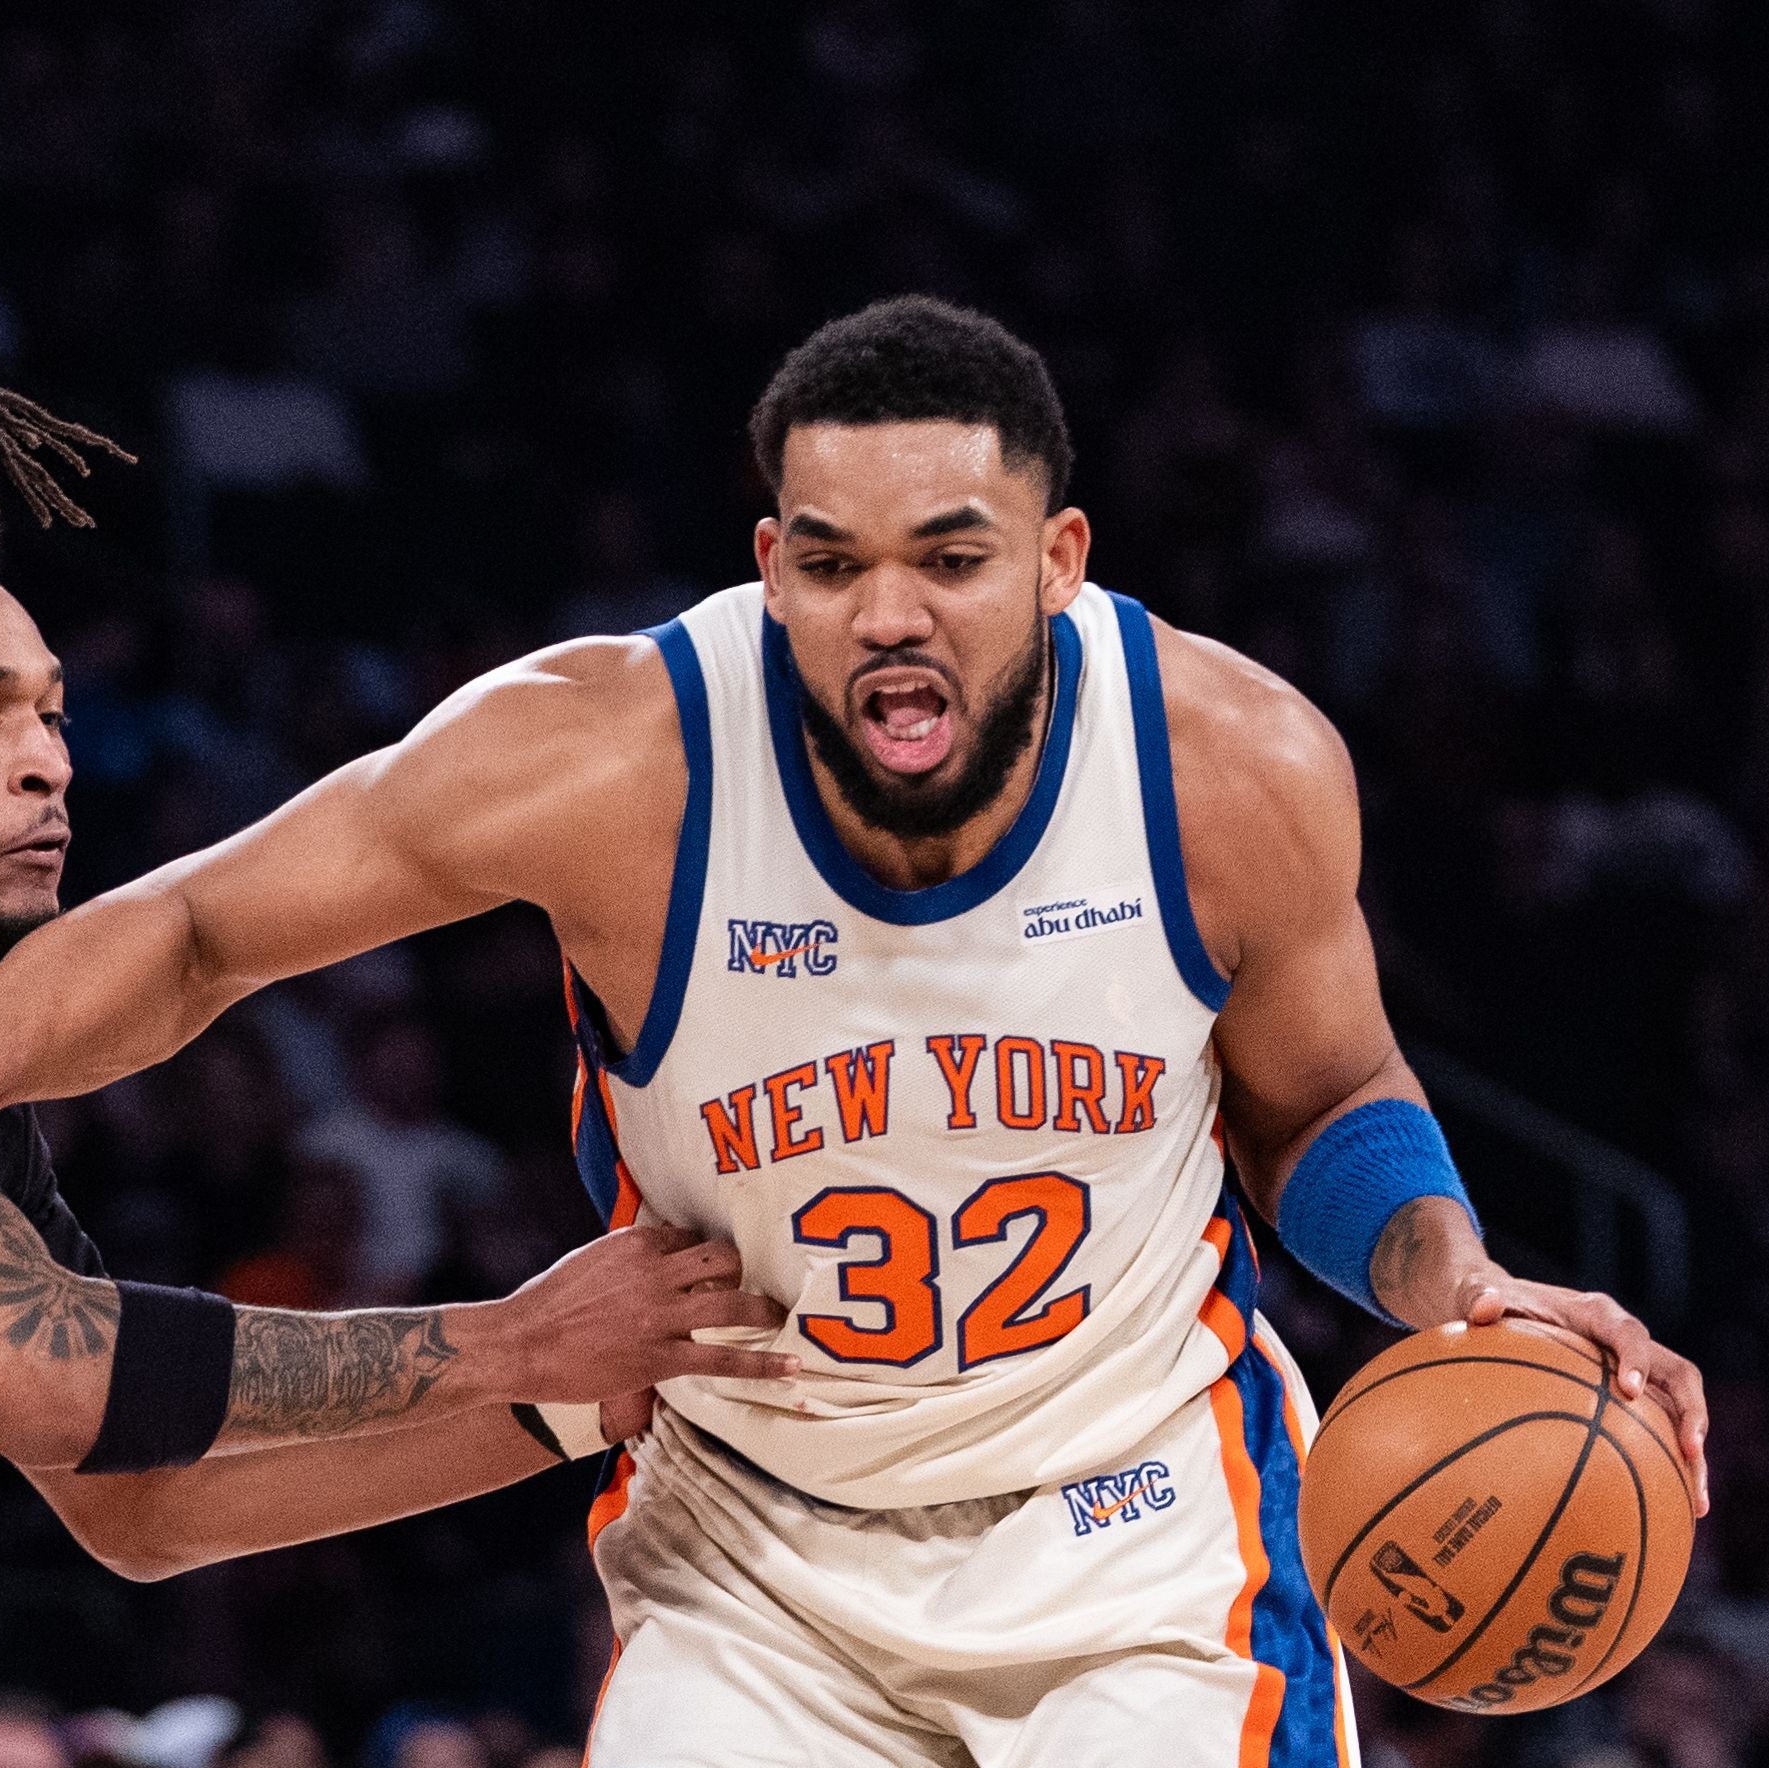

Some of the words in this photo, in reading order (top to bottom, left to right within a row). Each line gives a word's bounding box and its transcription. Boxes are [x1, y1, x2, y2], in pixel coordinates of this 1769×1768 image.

[1023, 898, 1088, 917] experience
[1024, 917, 1071, 939] abu
[1074, 897, 1143, 929] dhabi
[727, 919, 838, 979] NYC
[700, 1039, 894, 1175] NEW
[926, 1034, 1166, 1135] YORK
[792, 1170, 1092, 1373] 32
[1061, 1461, 1176, 1537] NYC
